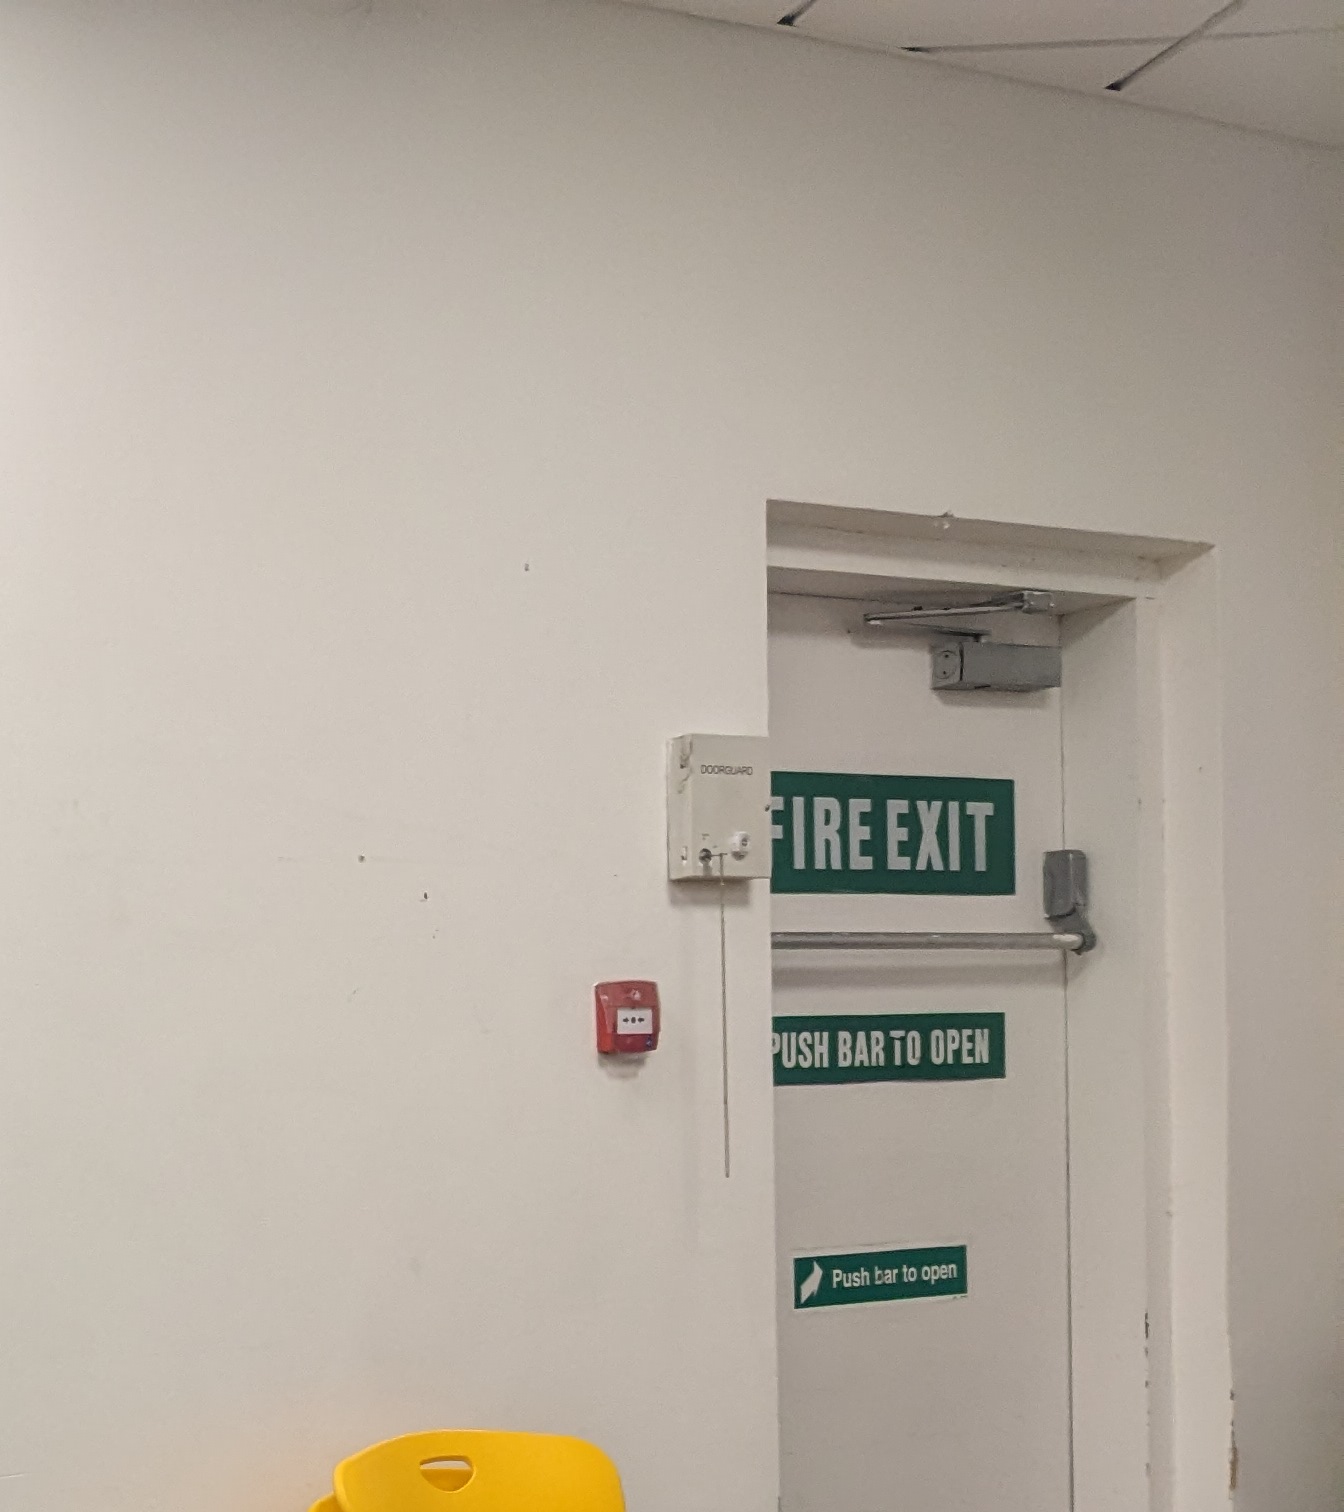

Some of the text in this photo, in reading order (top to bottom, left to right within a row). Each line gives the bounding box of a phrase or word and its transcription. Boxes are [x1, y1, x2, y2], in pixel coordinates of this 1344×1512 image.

[700, 764, 753, 775] DOORGUARD
[885, 799, 995, 871] EXIT
[838, 1030, 885, 1067] BAR
[889, 1030, 921, 1066] TO
[931, 1029, 989, 1065] OPEN
[832, 1263, 957, 1288] Push bar to open
